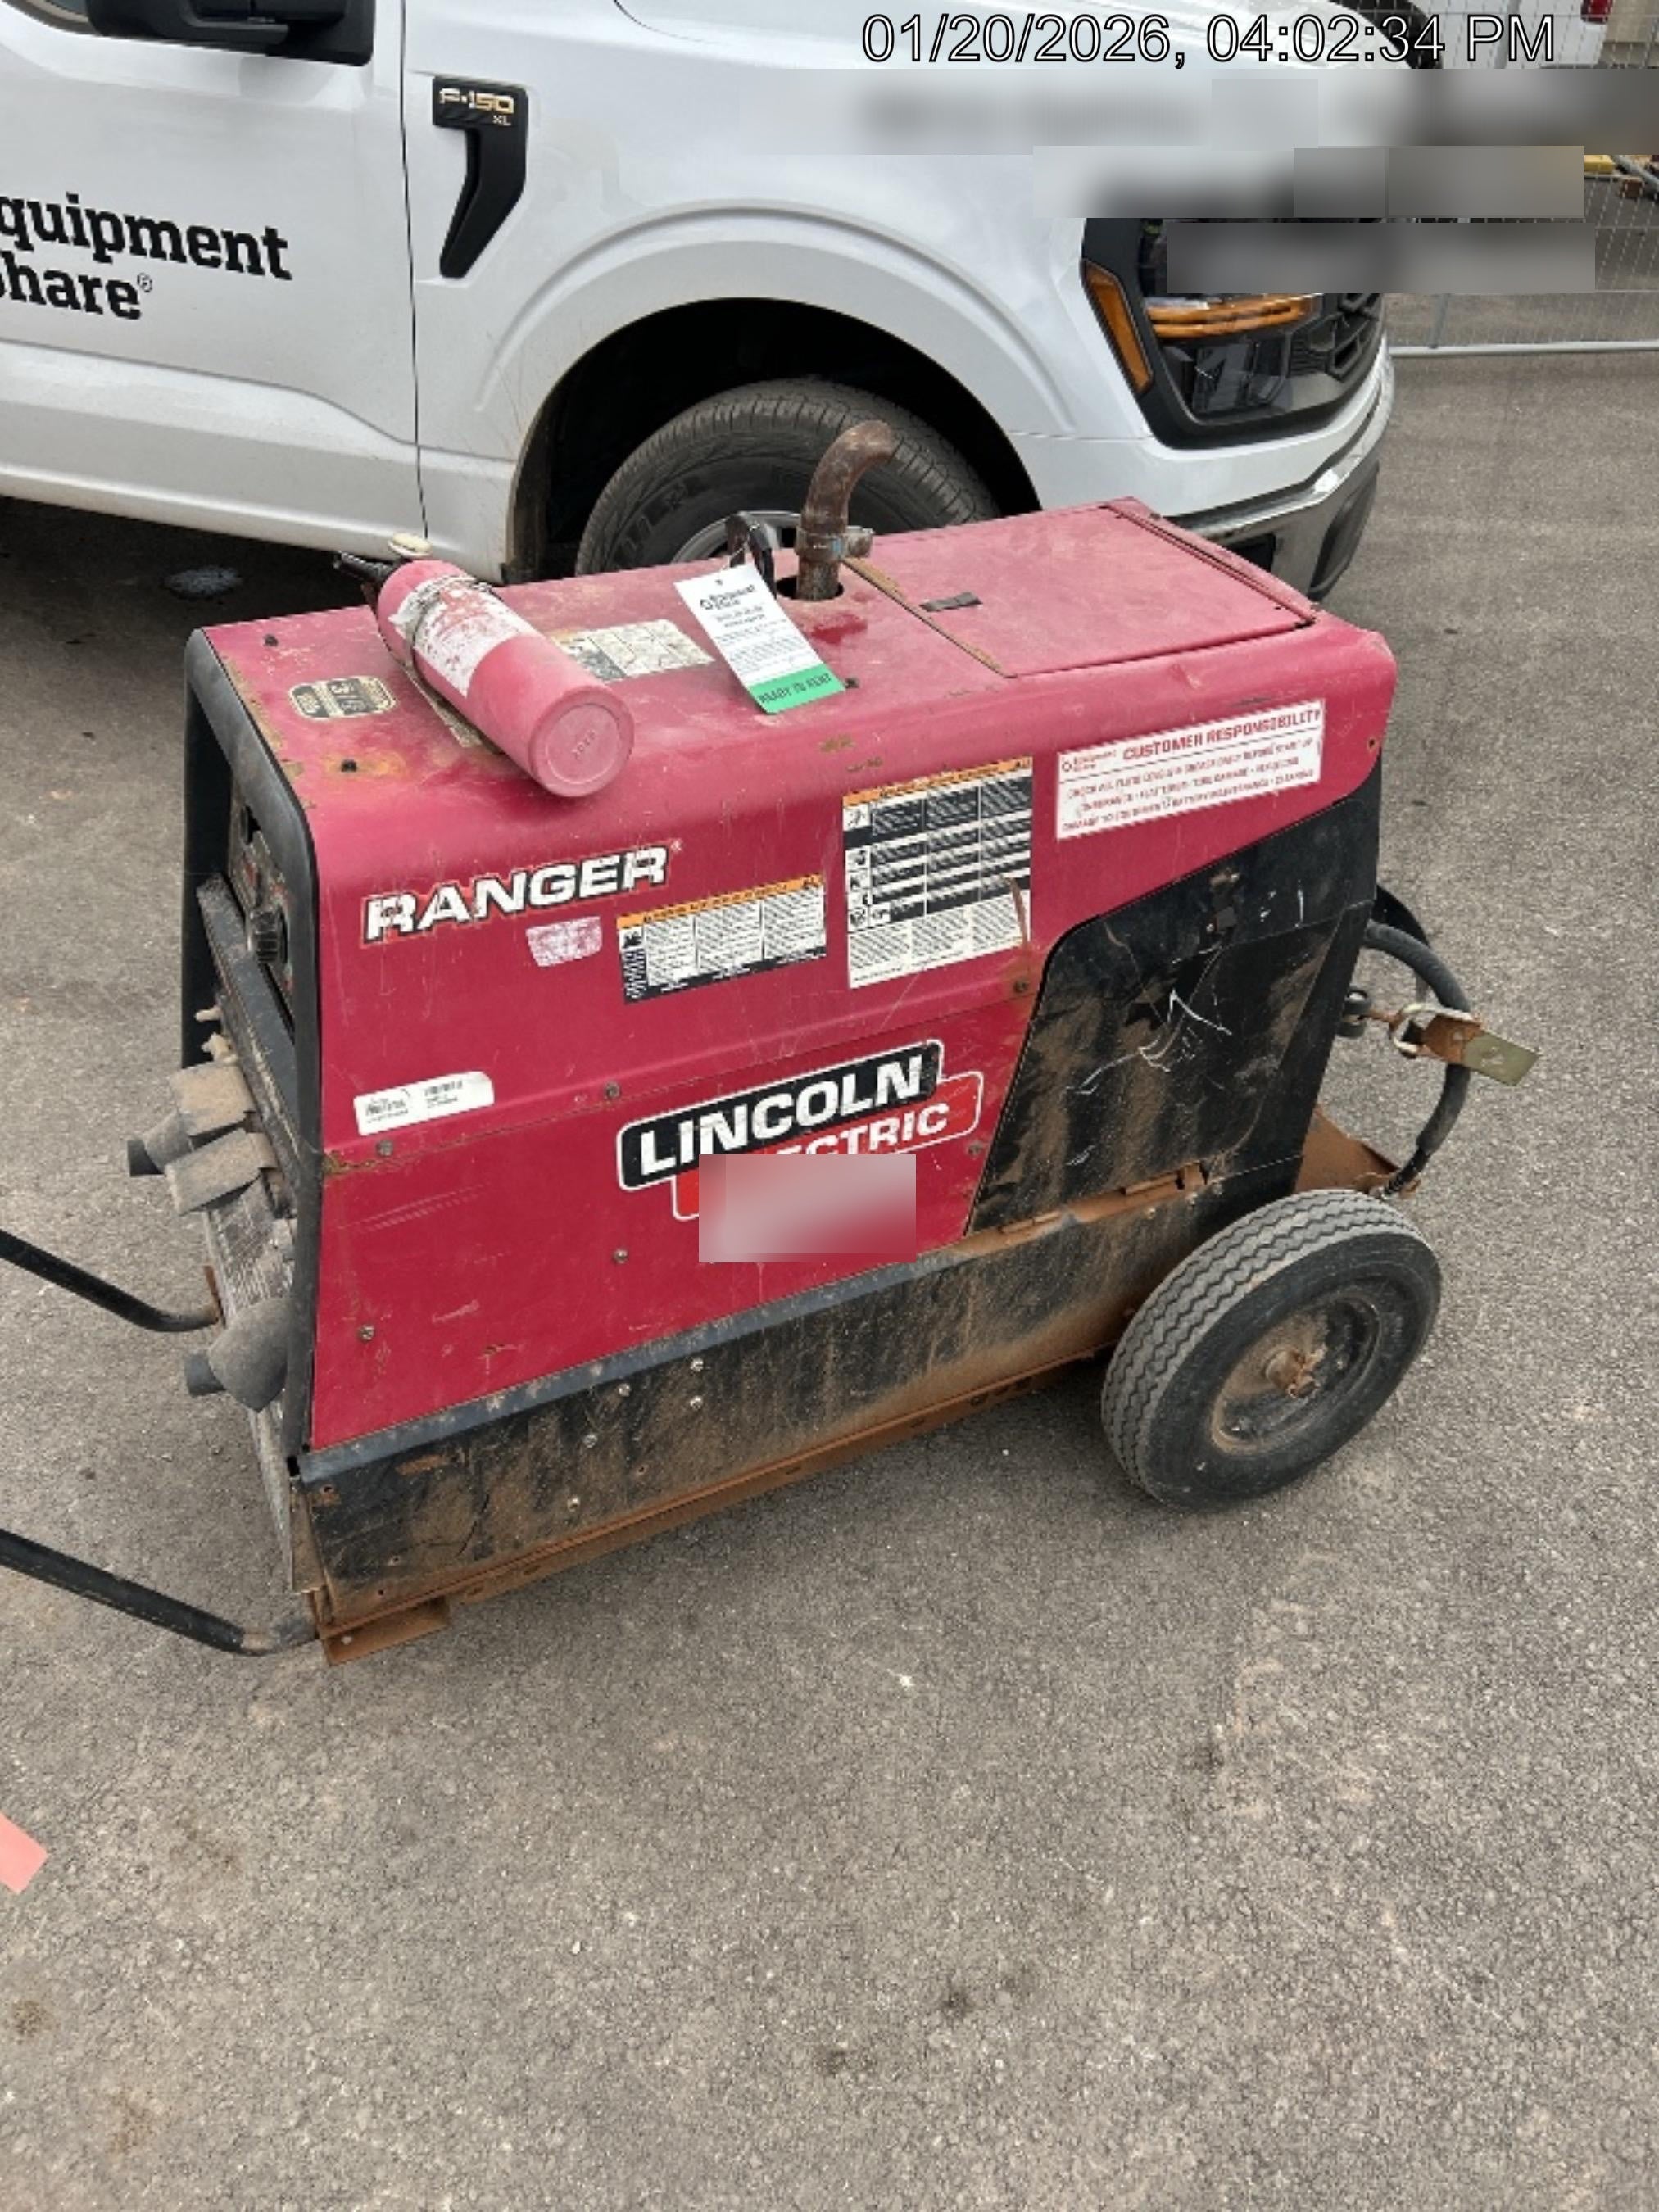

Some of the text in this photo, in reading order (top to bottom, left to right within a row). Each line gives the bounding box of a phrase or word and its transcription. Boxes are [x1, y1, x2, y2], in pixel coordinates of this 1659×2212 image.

[438, 87, 514, 114] F-150
[492, 115, 512, 126] XL
[0, 249, 142, 320] hare
[1122, 709, 1321, 761] CUSTOMER RESPONSIBILITY
[363, 845, 670, 944] RANGER
[640, 1054, 923, 1176] LINCOLN
